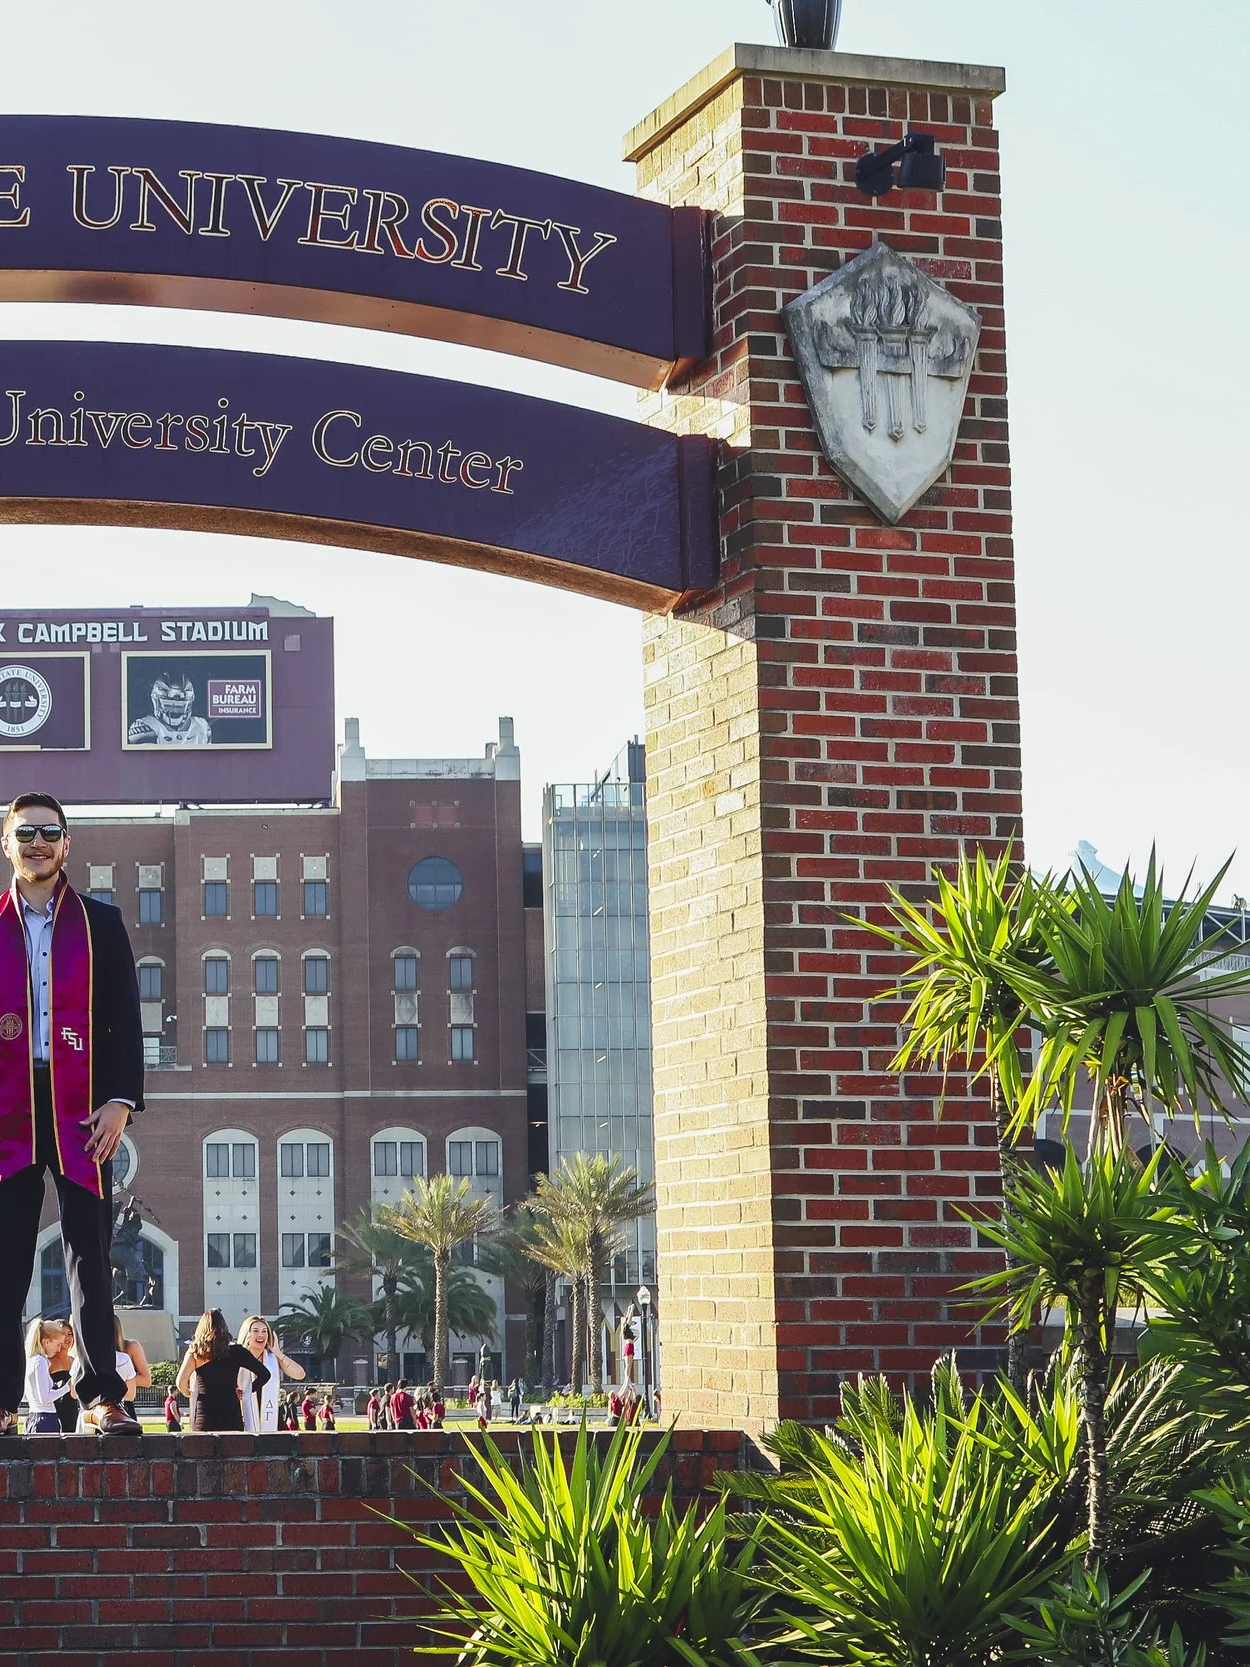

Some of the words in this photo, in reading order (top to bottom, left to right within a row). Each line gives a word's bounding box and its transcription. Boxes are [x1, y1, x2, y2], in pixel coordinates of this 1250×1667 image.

[66, 164, 617, 295] UNIVERSITY
[311, 410, 524, 496] Center
[17, 622, 148, 643] CAMPBELL
[160, 620, 269, 642] STADIUM
[25, 671, 47, 719] UNIVERSITY
[212, 694, 256, 704] BUREAU
[225, 684, 256, 694] FARM
[6, 725, 25, 733] 1851
[61, 1027, 83, 1050] FSU
